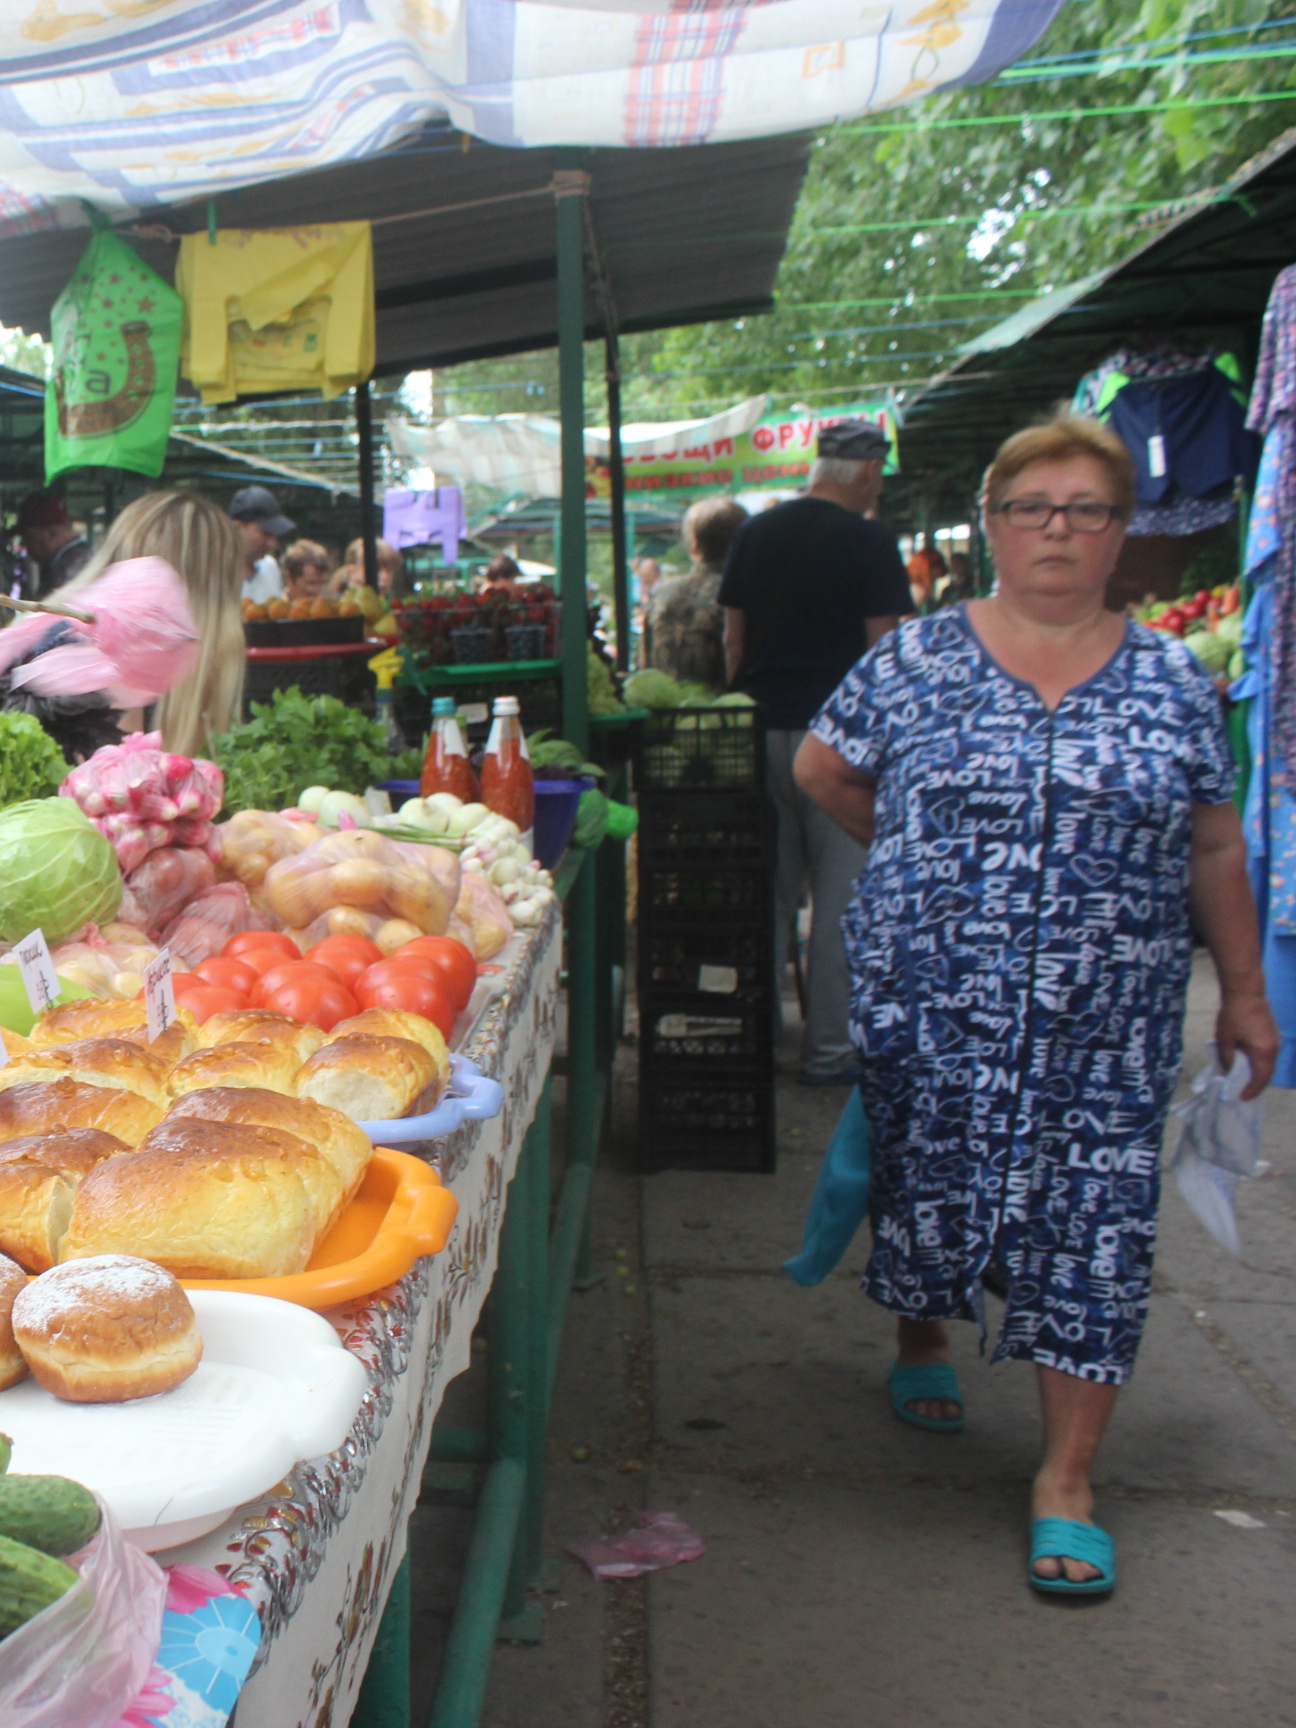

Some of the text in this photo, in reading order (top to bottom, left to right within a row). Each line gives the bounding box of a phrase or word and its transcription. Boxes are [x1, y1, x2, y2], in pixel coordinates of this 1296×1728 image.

[926, 770, 992, 788] LOVE
[968, 752, 1018, 778] love
[960, 818, 1024, 834] LOVE
[1052, 812, 1088, 855] love
[1110, 933, 1174, 967] LOVE
[931, 992, 985, 1009] LOVE
[1067, 1142, 1156, 1176] LOVE
[914, 1199, 945, 1247] love
[1089, 1223, 1122, 1278] love
[1050, 1252, 1088, 1288] love
[1042, 1294, 1087, 1322] love
[1007, 1310, 1112, 1345] LOVE
